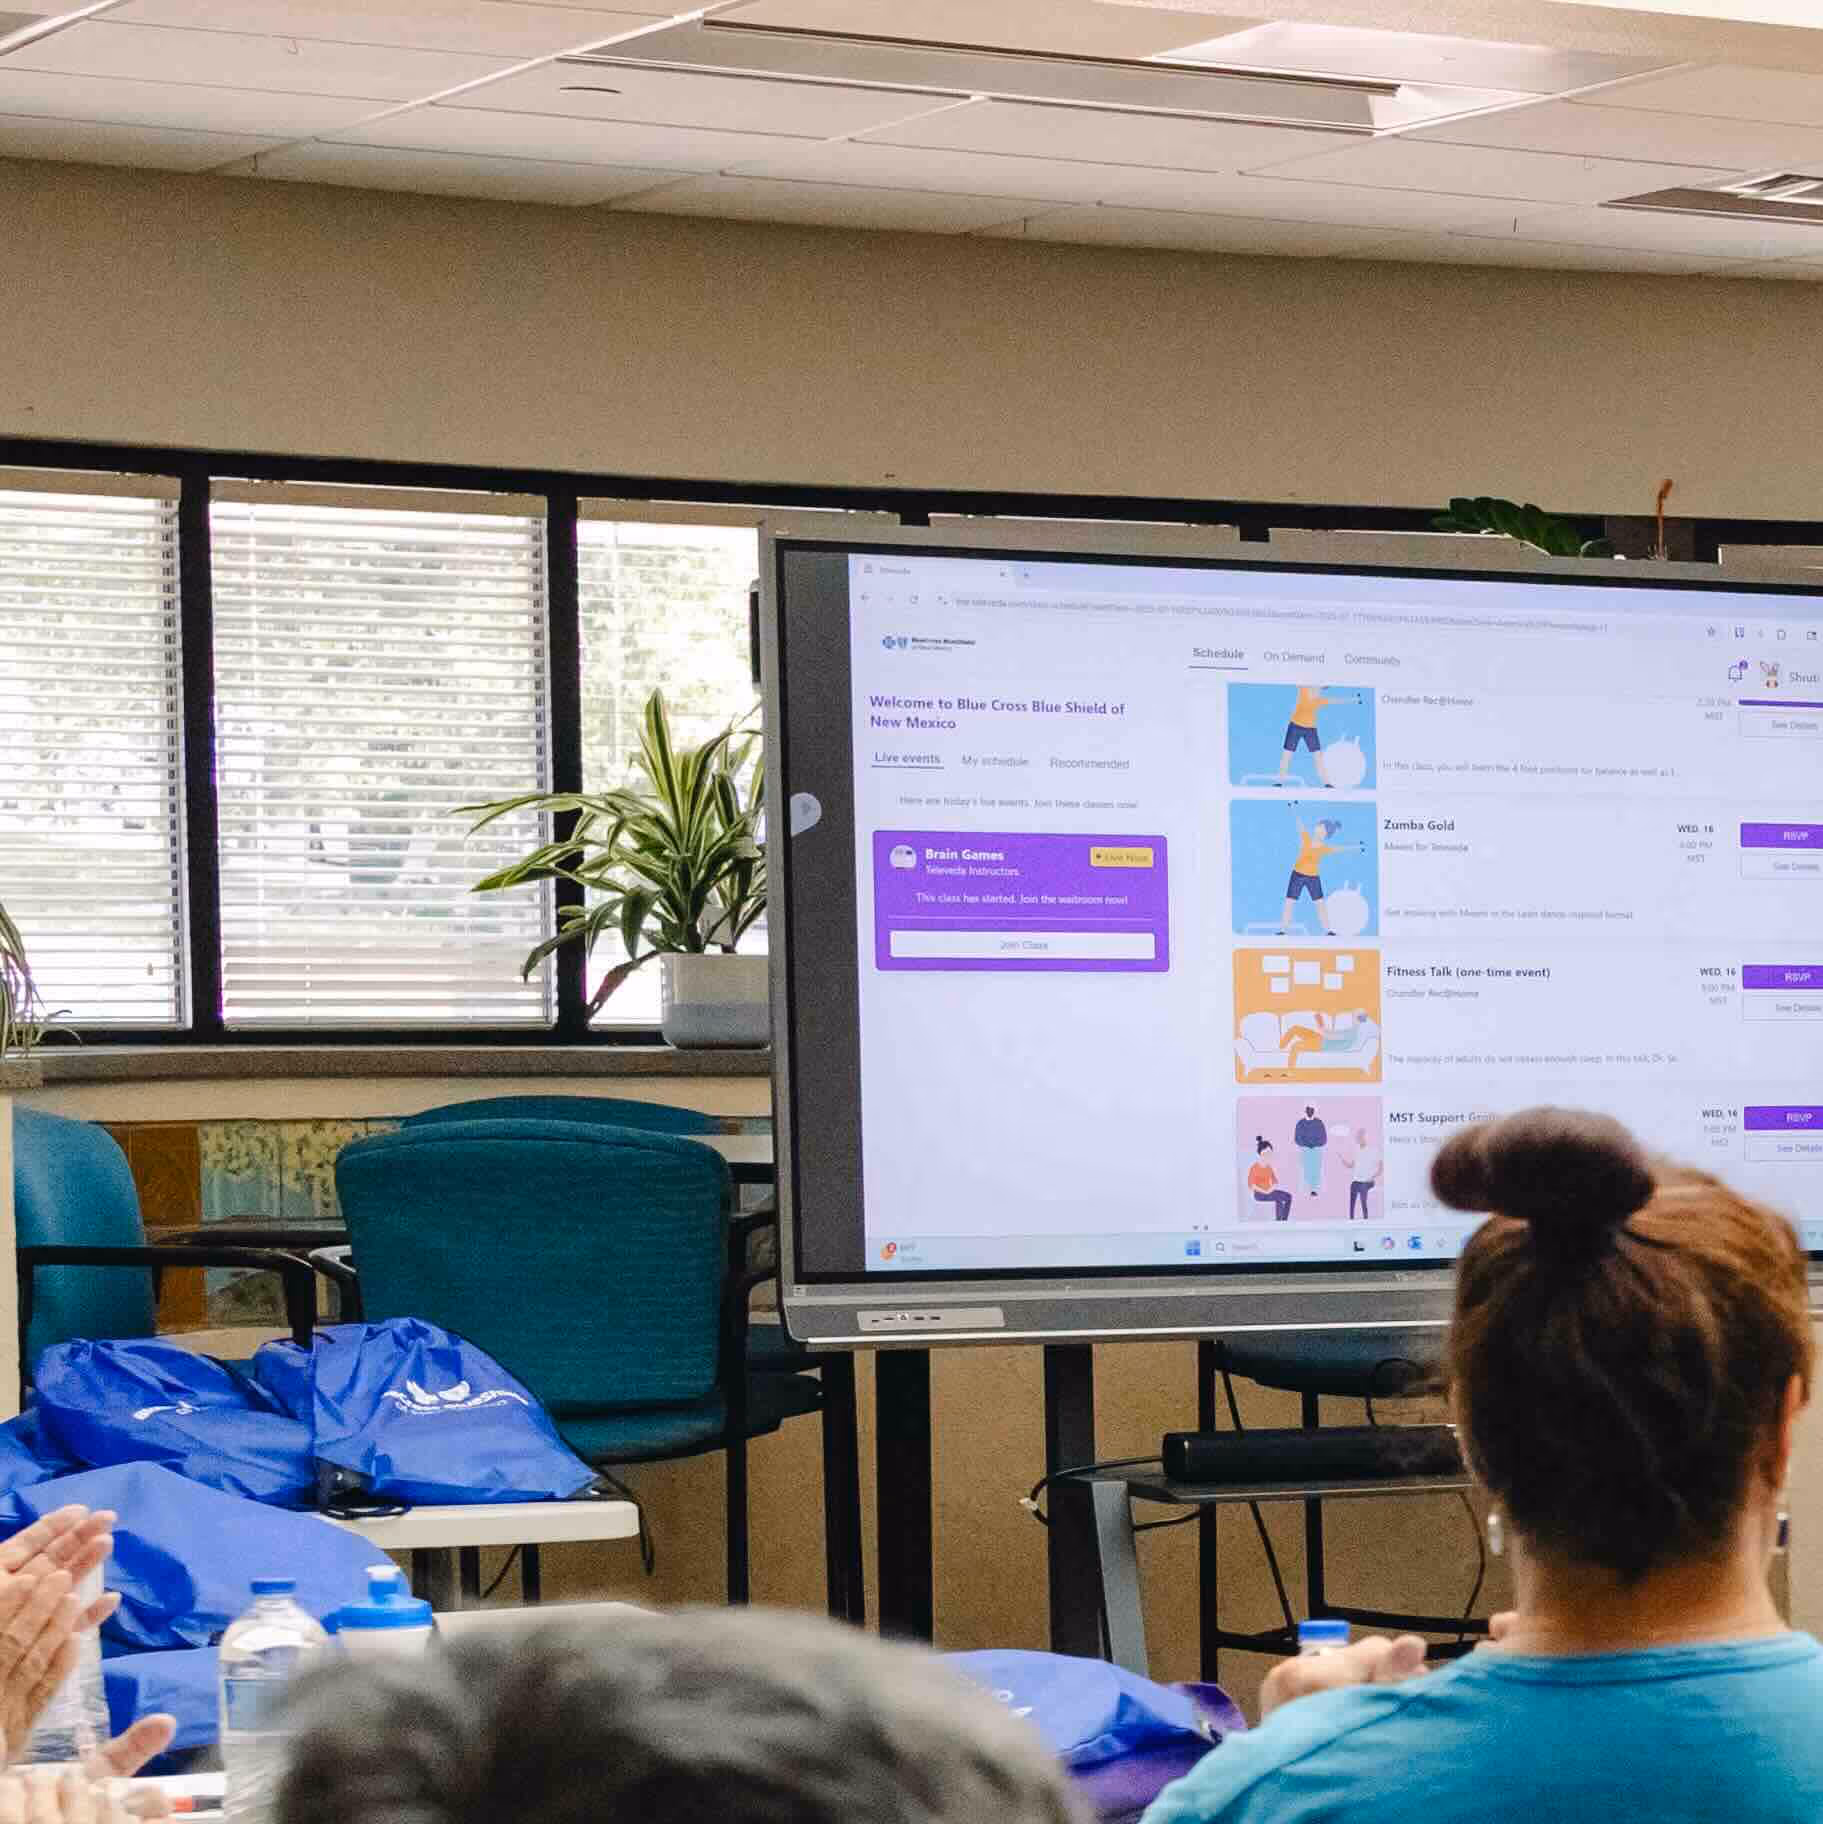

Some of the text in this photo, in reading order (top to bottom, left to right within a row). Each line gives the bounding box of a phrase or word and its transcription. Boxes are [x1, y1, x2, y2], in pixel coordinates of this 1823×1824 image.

[1193, 648, 1245, 660] Schedule
[870, 695, 1126, 715] Welcome to Blue Cross Blue Shield of
[870, 715, 957, 730] New Mexico
[875, 751, 941, 765] Live events
[961, 755, 978, 768] My
[1050, 755, 1131, 770] Recommended
[1383, 819, 1455, 832] Zumba Gold
[926, 848, 1005, 862] Brain Games
[917, 892, 938, 904] This
[938, 893, 961, 904] class
[963, 893, 979, 904] has
[1019, 894, 1038, 906] Join
[1040, 894, 1057, 905] the
[1105, 895, 1128, 906] now!
[1387, 966, 1551, 979] Fitness Talk (one-time event)
[1726, 967, 1736, 977] 16
[1389, 1111, 1496, 1125] MST Support Grou
[1728, 1109, 1738, 1119] 16
[1786, 1112, 1813, 1122] RSVP
